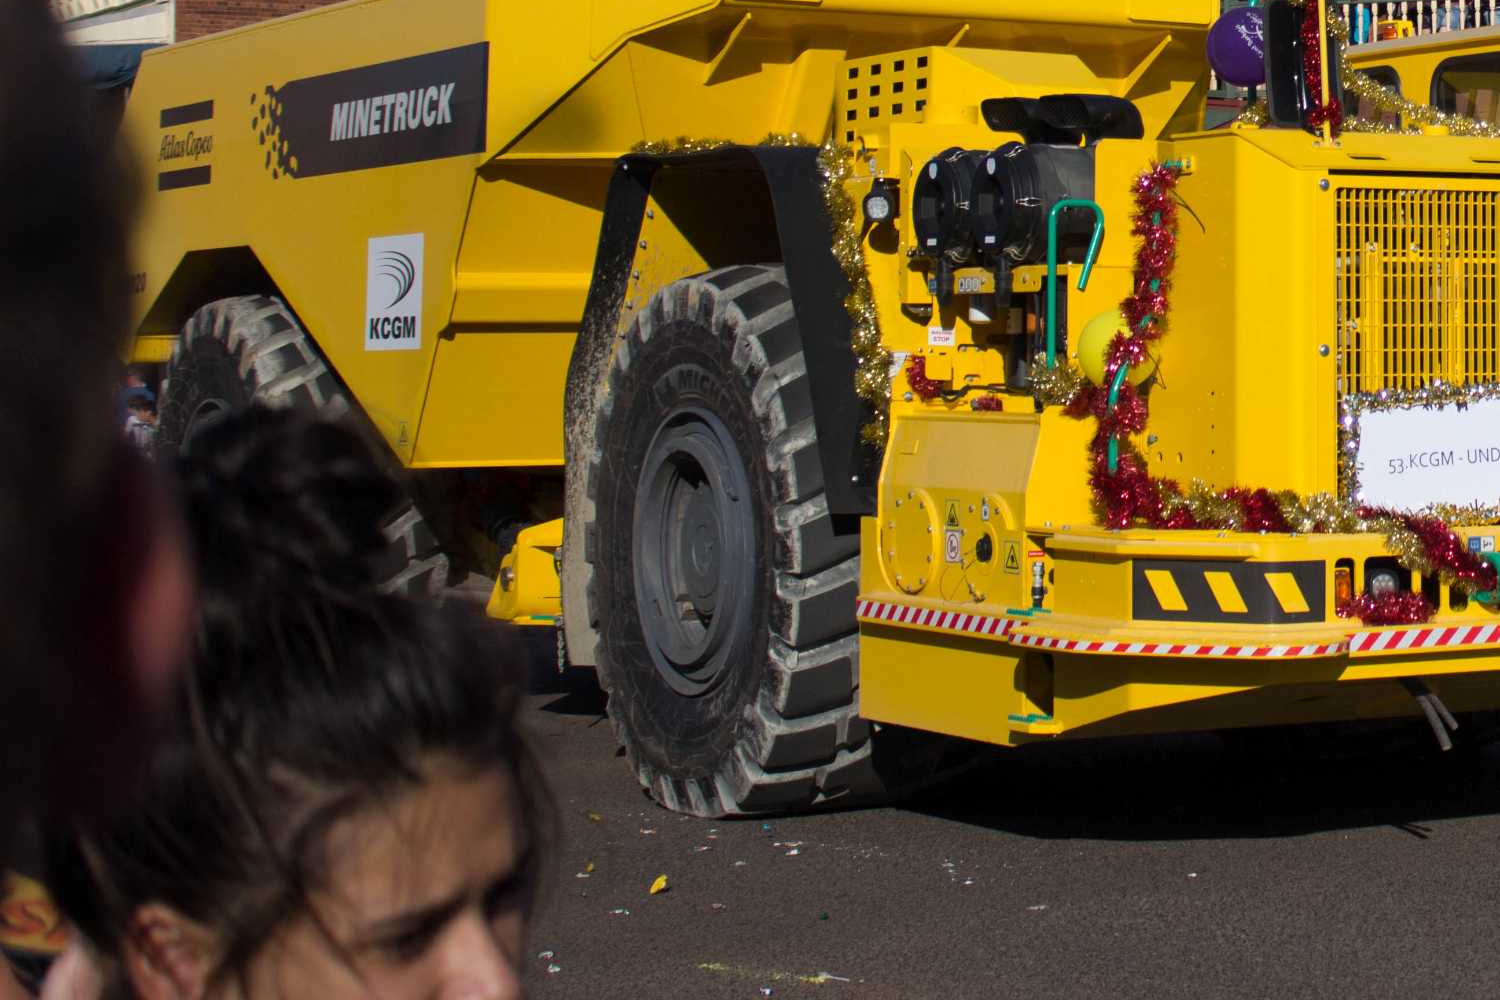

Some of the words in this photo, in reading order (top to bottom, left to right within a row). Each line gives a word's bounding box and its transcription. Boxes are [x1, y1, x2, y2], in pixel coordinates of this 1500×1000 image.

[329, 82, 456, 142] MINETRUCK
[369, 316, 417, 339] KCGM
[1409, 450, 1455, 468] KCGM
